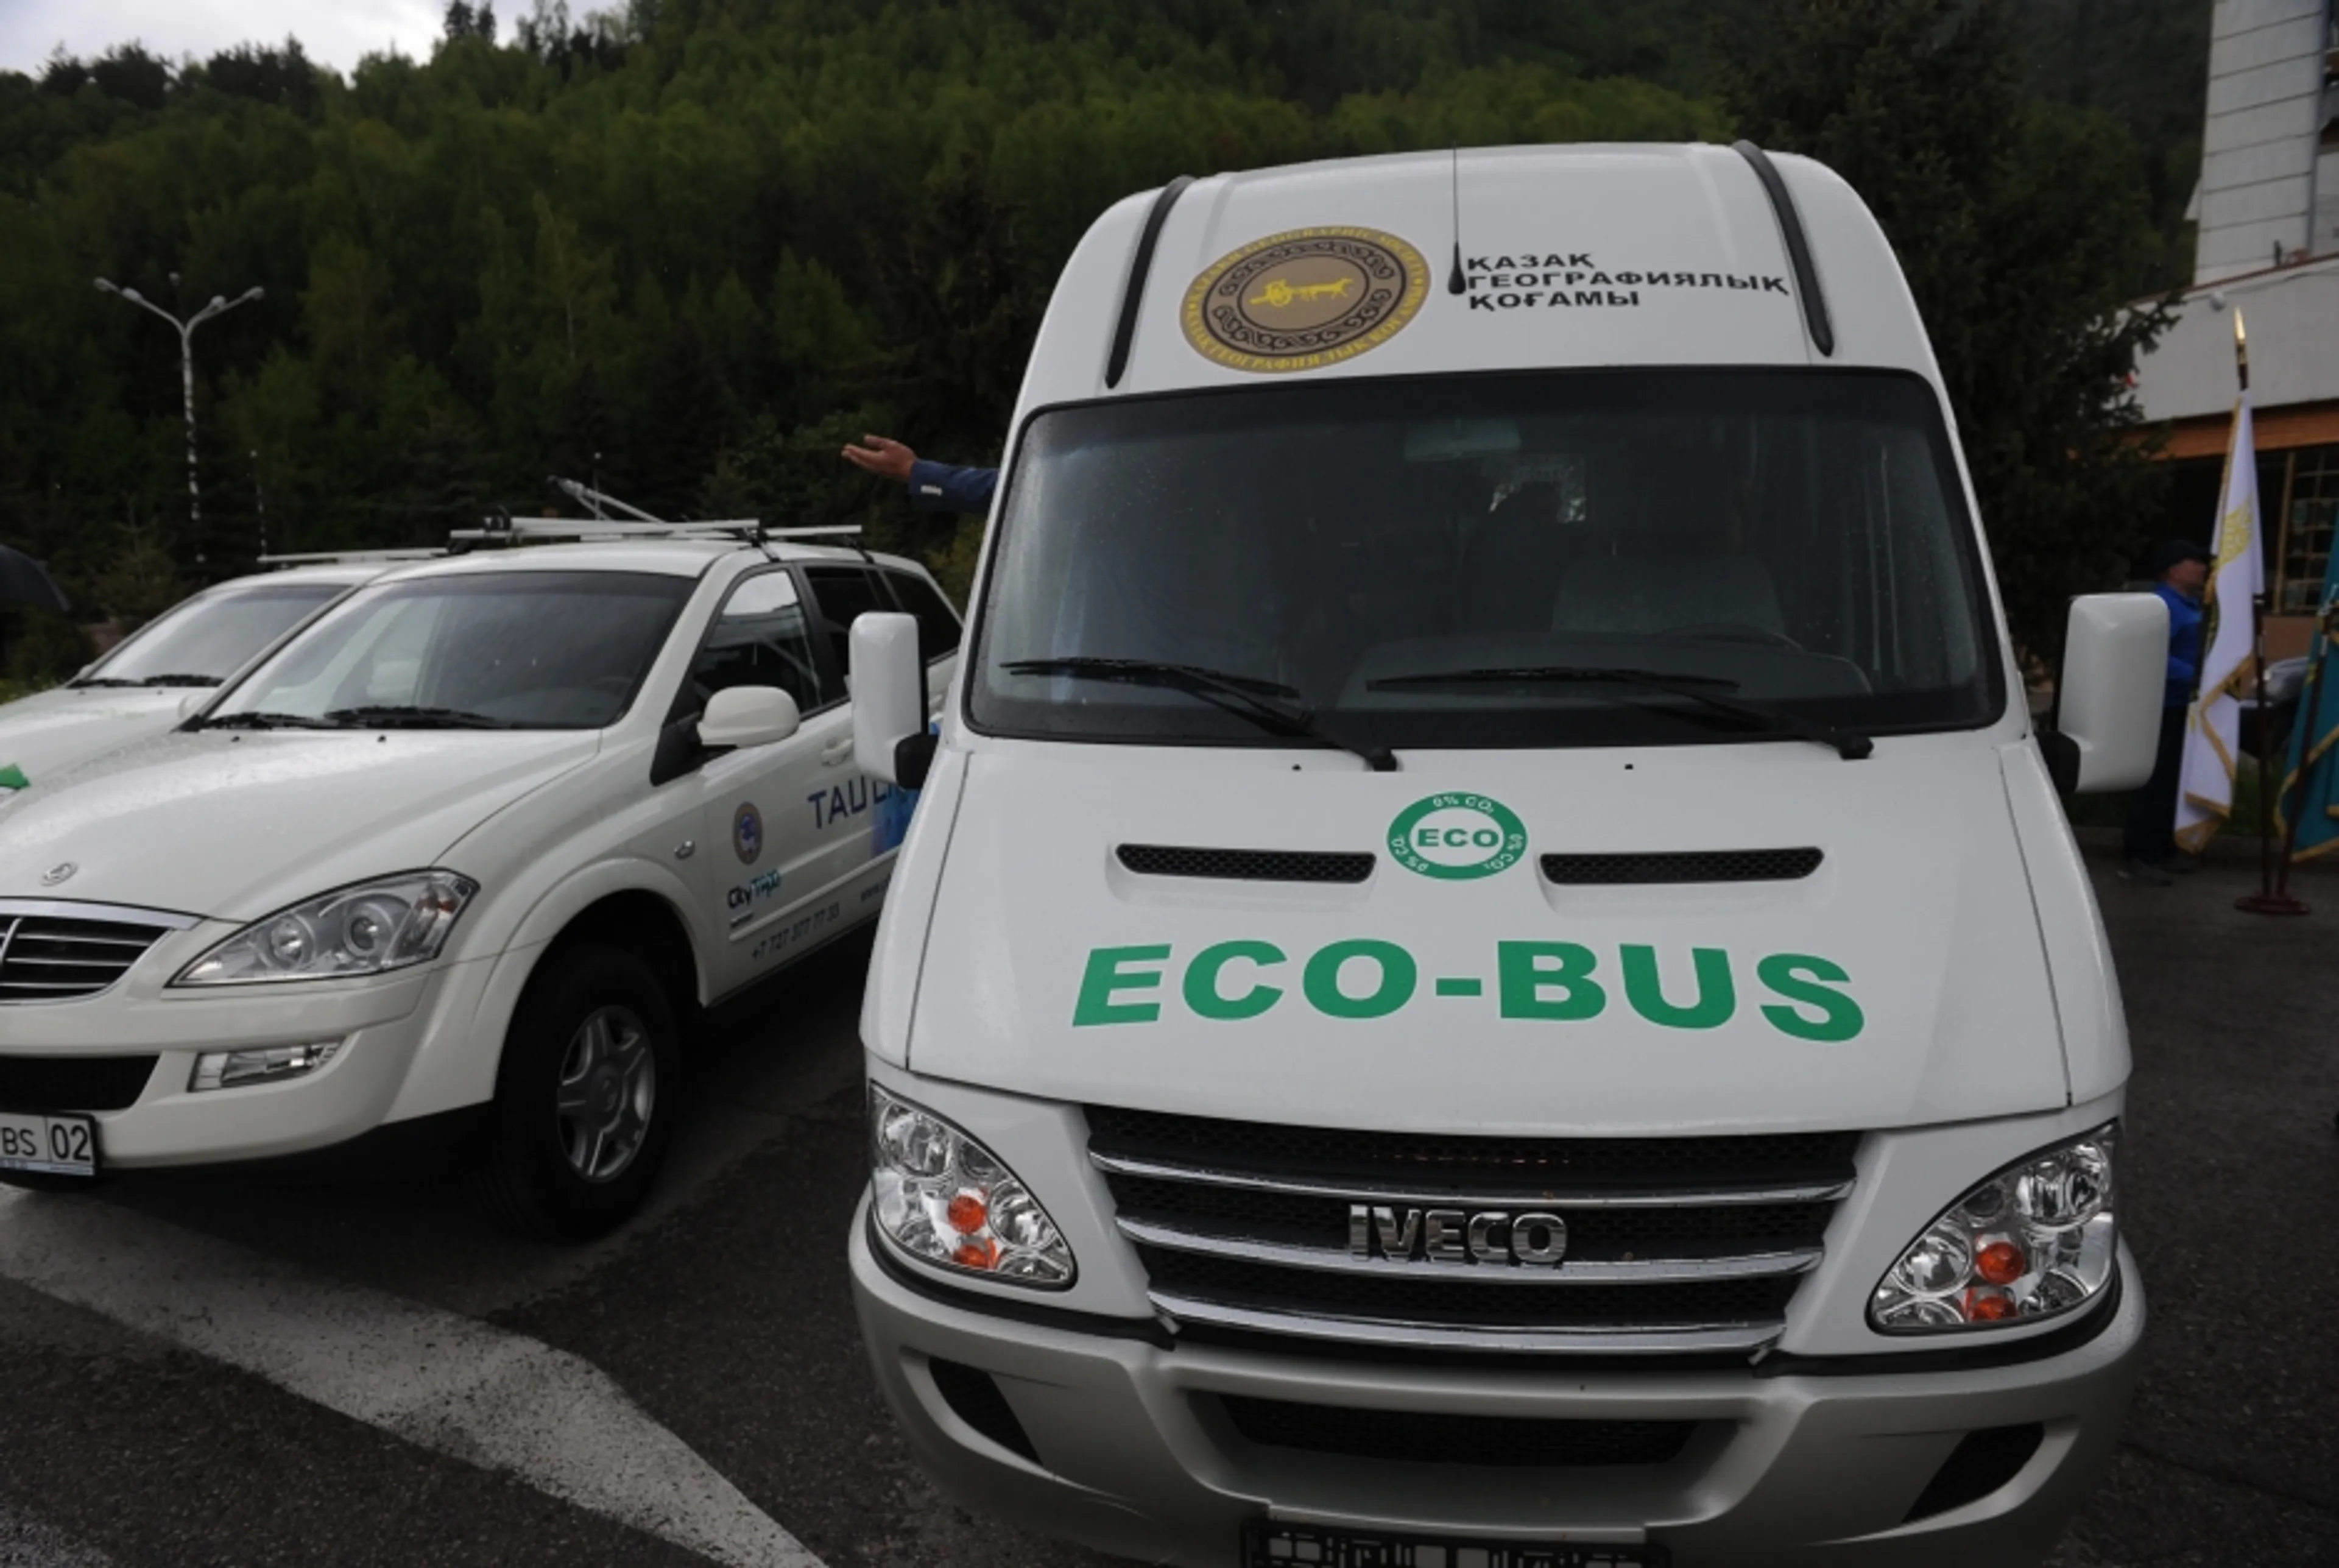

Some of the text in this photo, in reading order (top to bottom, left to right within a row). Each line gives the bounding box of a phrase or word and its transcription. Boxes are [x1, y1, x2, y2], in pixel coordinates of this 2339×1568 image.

[1467, 271, 1790, 296] ГЕОГРАФИЯЛЫҚ
[1417, 828, 1499, 847] ECO
[1072, 939, 1864, 1043] ECO-BUS
[52, 1124, 91, 1161] 02
[1349, 1204, 1568, 1263] IVECO
